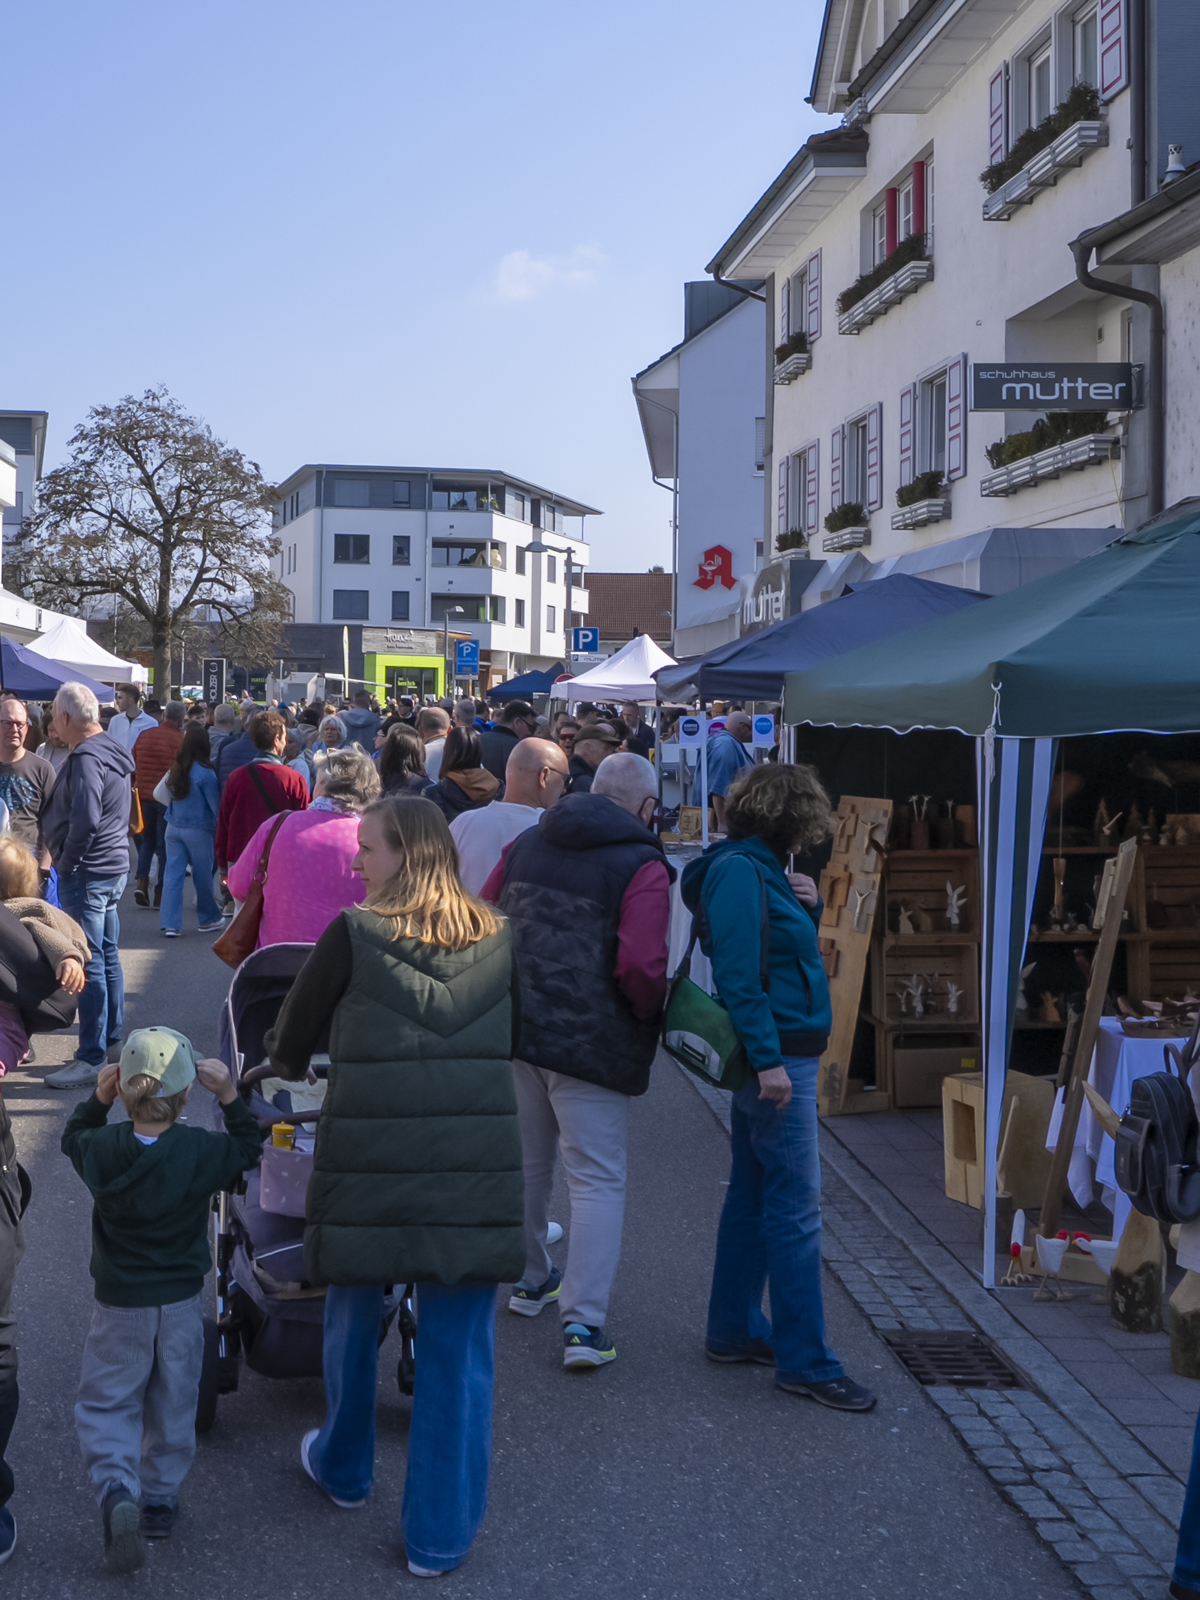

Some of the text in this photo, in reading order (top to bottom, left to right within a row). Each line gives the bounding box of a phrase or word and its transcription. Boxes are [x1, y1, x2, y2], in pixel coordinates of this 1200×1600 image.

[979, 369, 1057, 379] schuhhaus
[1001, 377, 1127, 400] mutter
[579, 630, 593, 649] P
[463, 645, 472, 657] P
[209, 674, 218, 703] HOLZER
